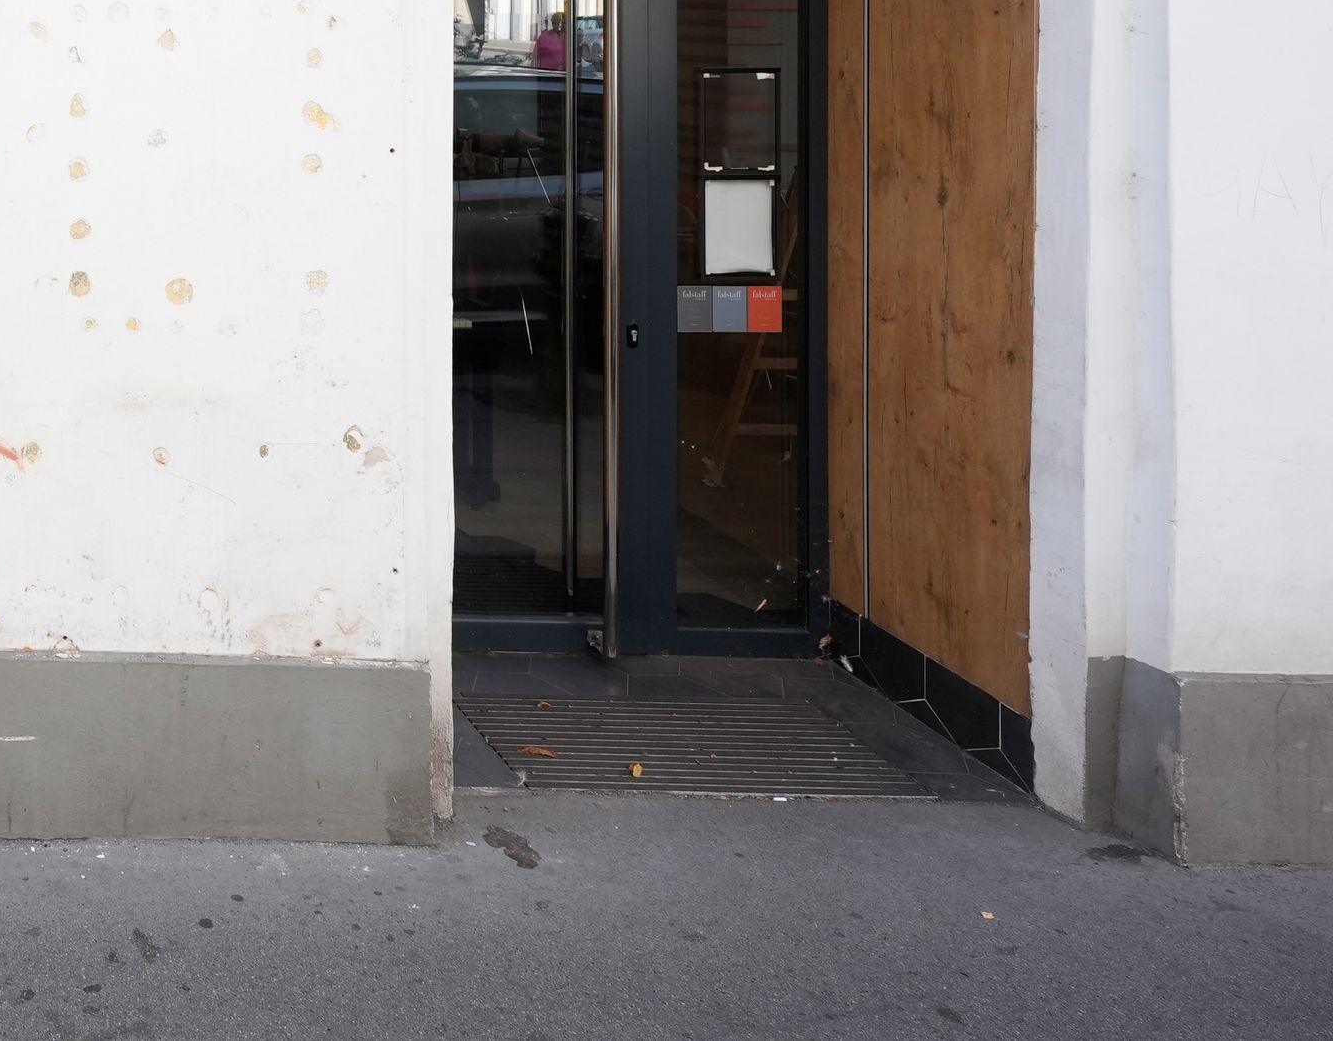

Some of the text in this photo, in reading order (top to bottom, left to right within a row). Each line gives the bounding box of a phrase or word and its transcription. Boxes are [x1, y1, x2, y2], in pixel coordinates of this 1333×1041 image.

[683, 290, 707, 298] falstaff
[717, 290, 741, 298] falstaff
[752, 290, 777, 298] falstaff
